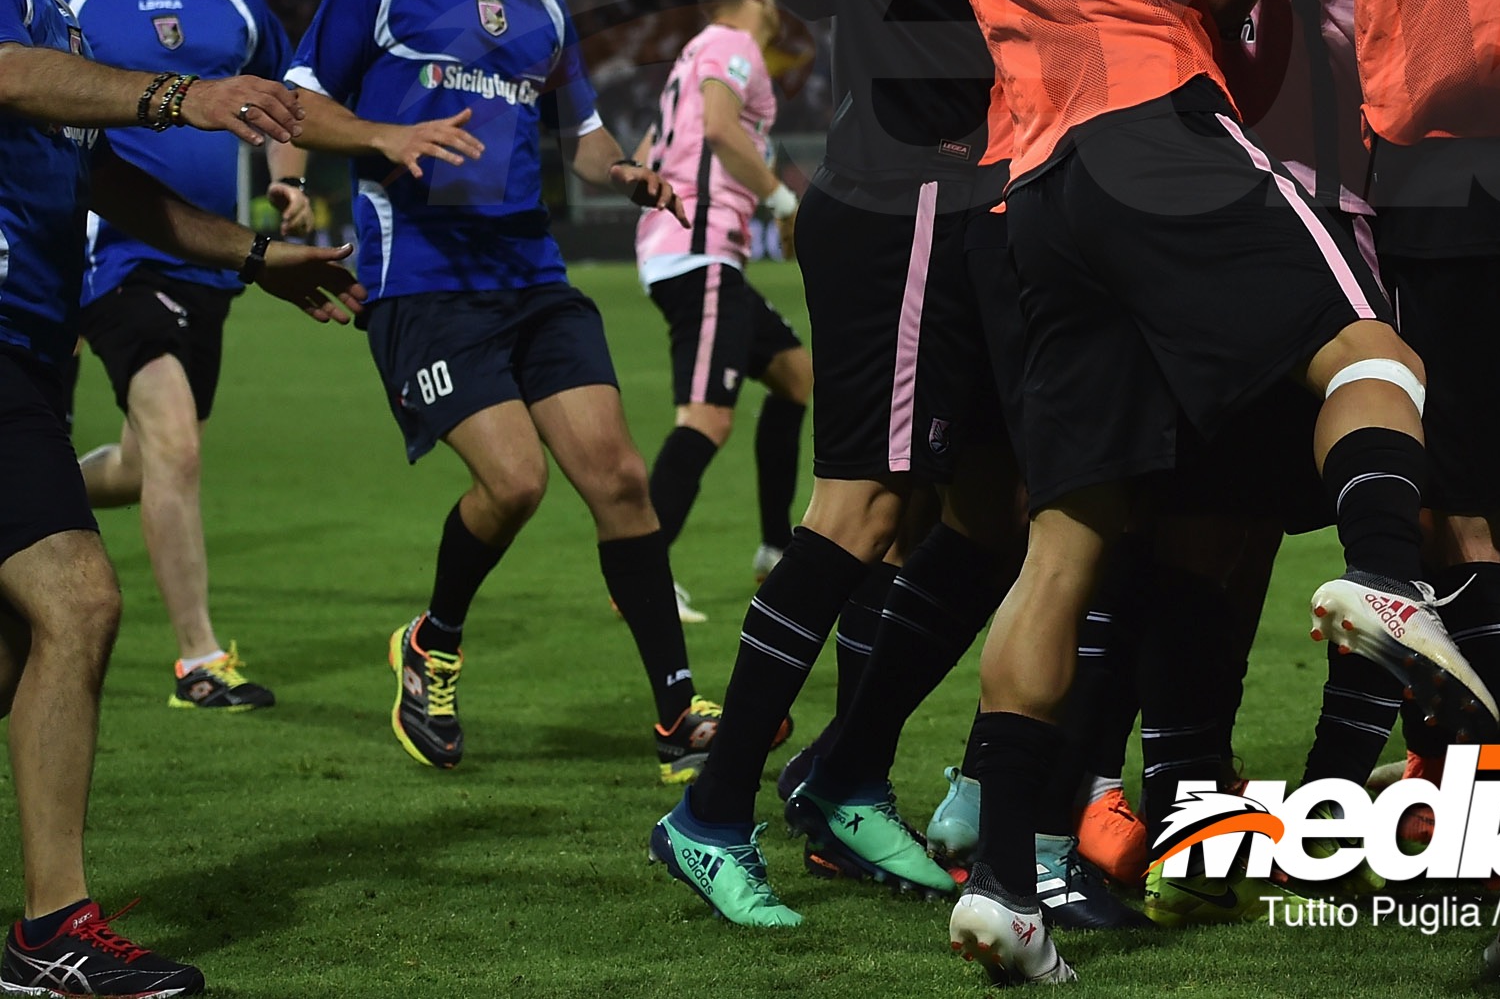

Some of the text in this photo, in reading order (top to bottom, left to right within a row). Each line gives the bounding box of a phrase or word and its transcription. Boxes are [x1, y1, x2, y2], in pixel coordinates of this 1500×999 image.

[416, 359, 454, 405] 80
[1364, 593, 1406, 639] adidas
[681, 848, 714, 895] adidas
